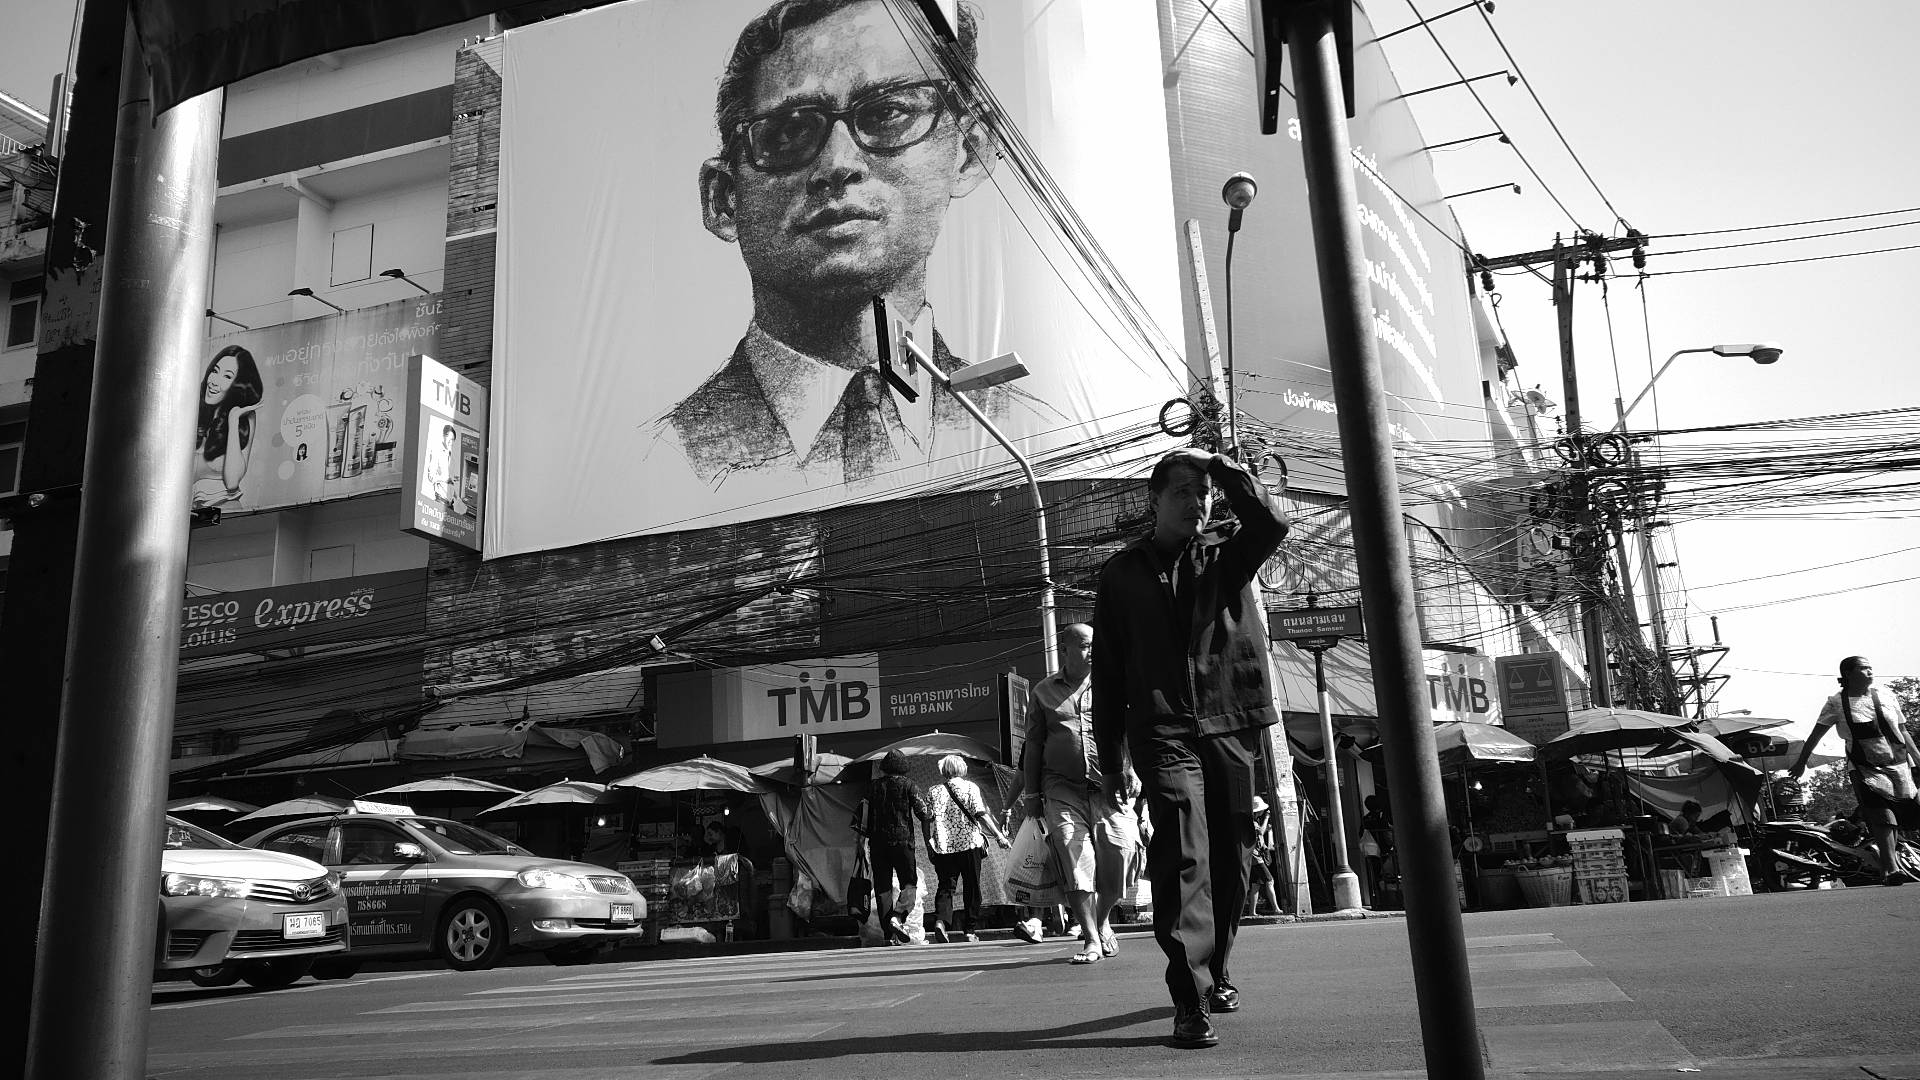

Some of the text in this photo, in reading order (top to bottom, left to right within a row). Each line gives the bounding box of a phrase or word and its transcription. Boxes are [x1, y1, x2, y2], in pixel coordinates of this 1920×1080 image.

[432, 379, 471, 416] TMB
[1283, 388, 1338, 415] ปวงข้าพระ
[295, 424, 303, 438] 5
[254, 594, 374, 631] express
[1283, 613, 1346, 627] ถนนสามเสน
[179, 627, 237, 648] otus
[767, 669, 871, 727] TMB
[890, 683, 990, 705] ธนาคารทหารไทย
[1425, 664, 1490, 713] TMB
[890, 702, 953, 717] TMB BANK
[304, 916, 321, 927] 7065
